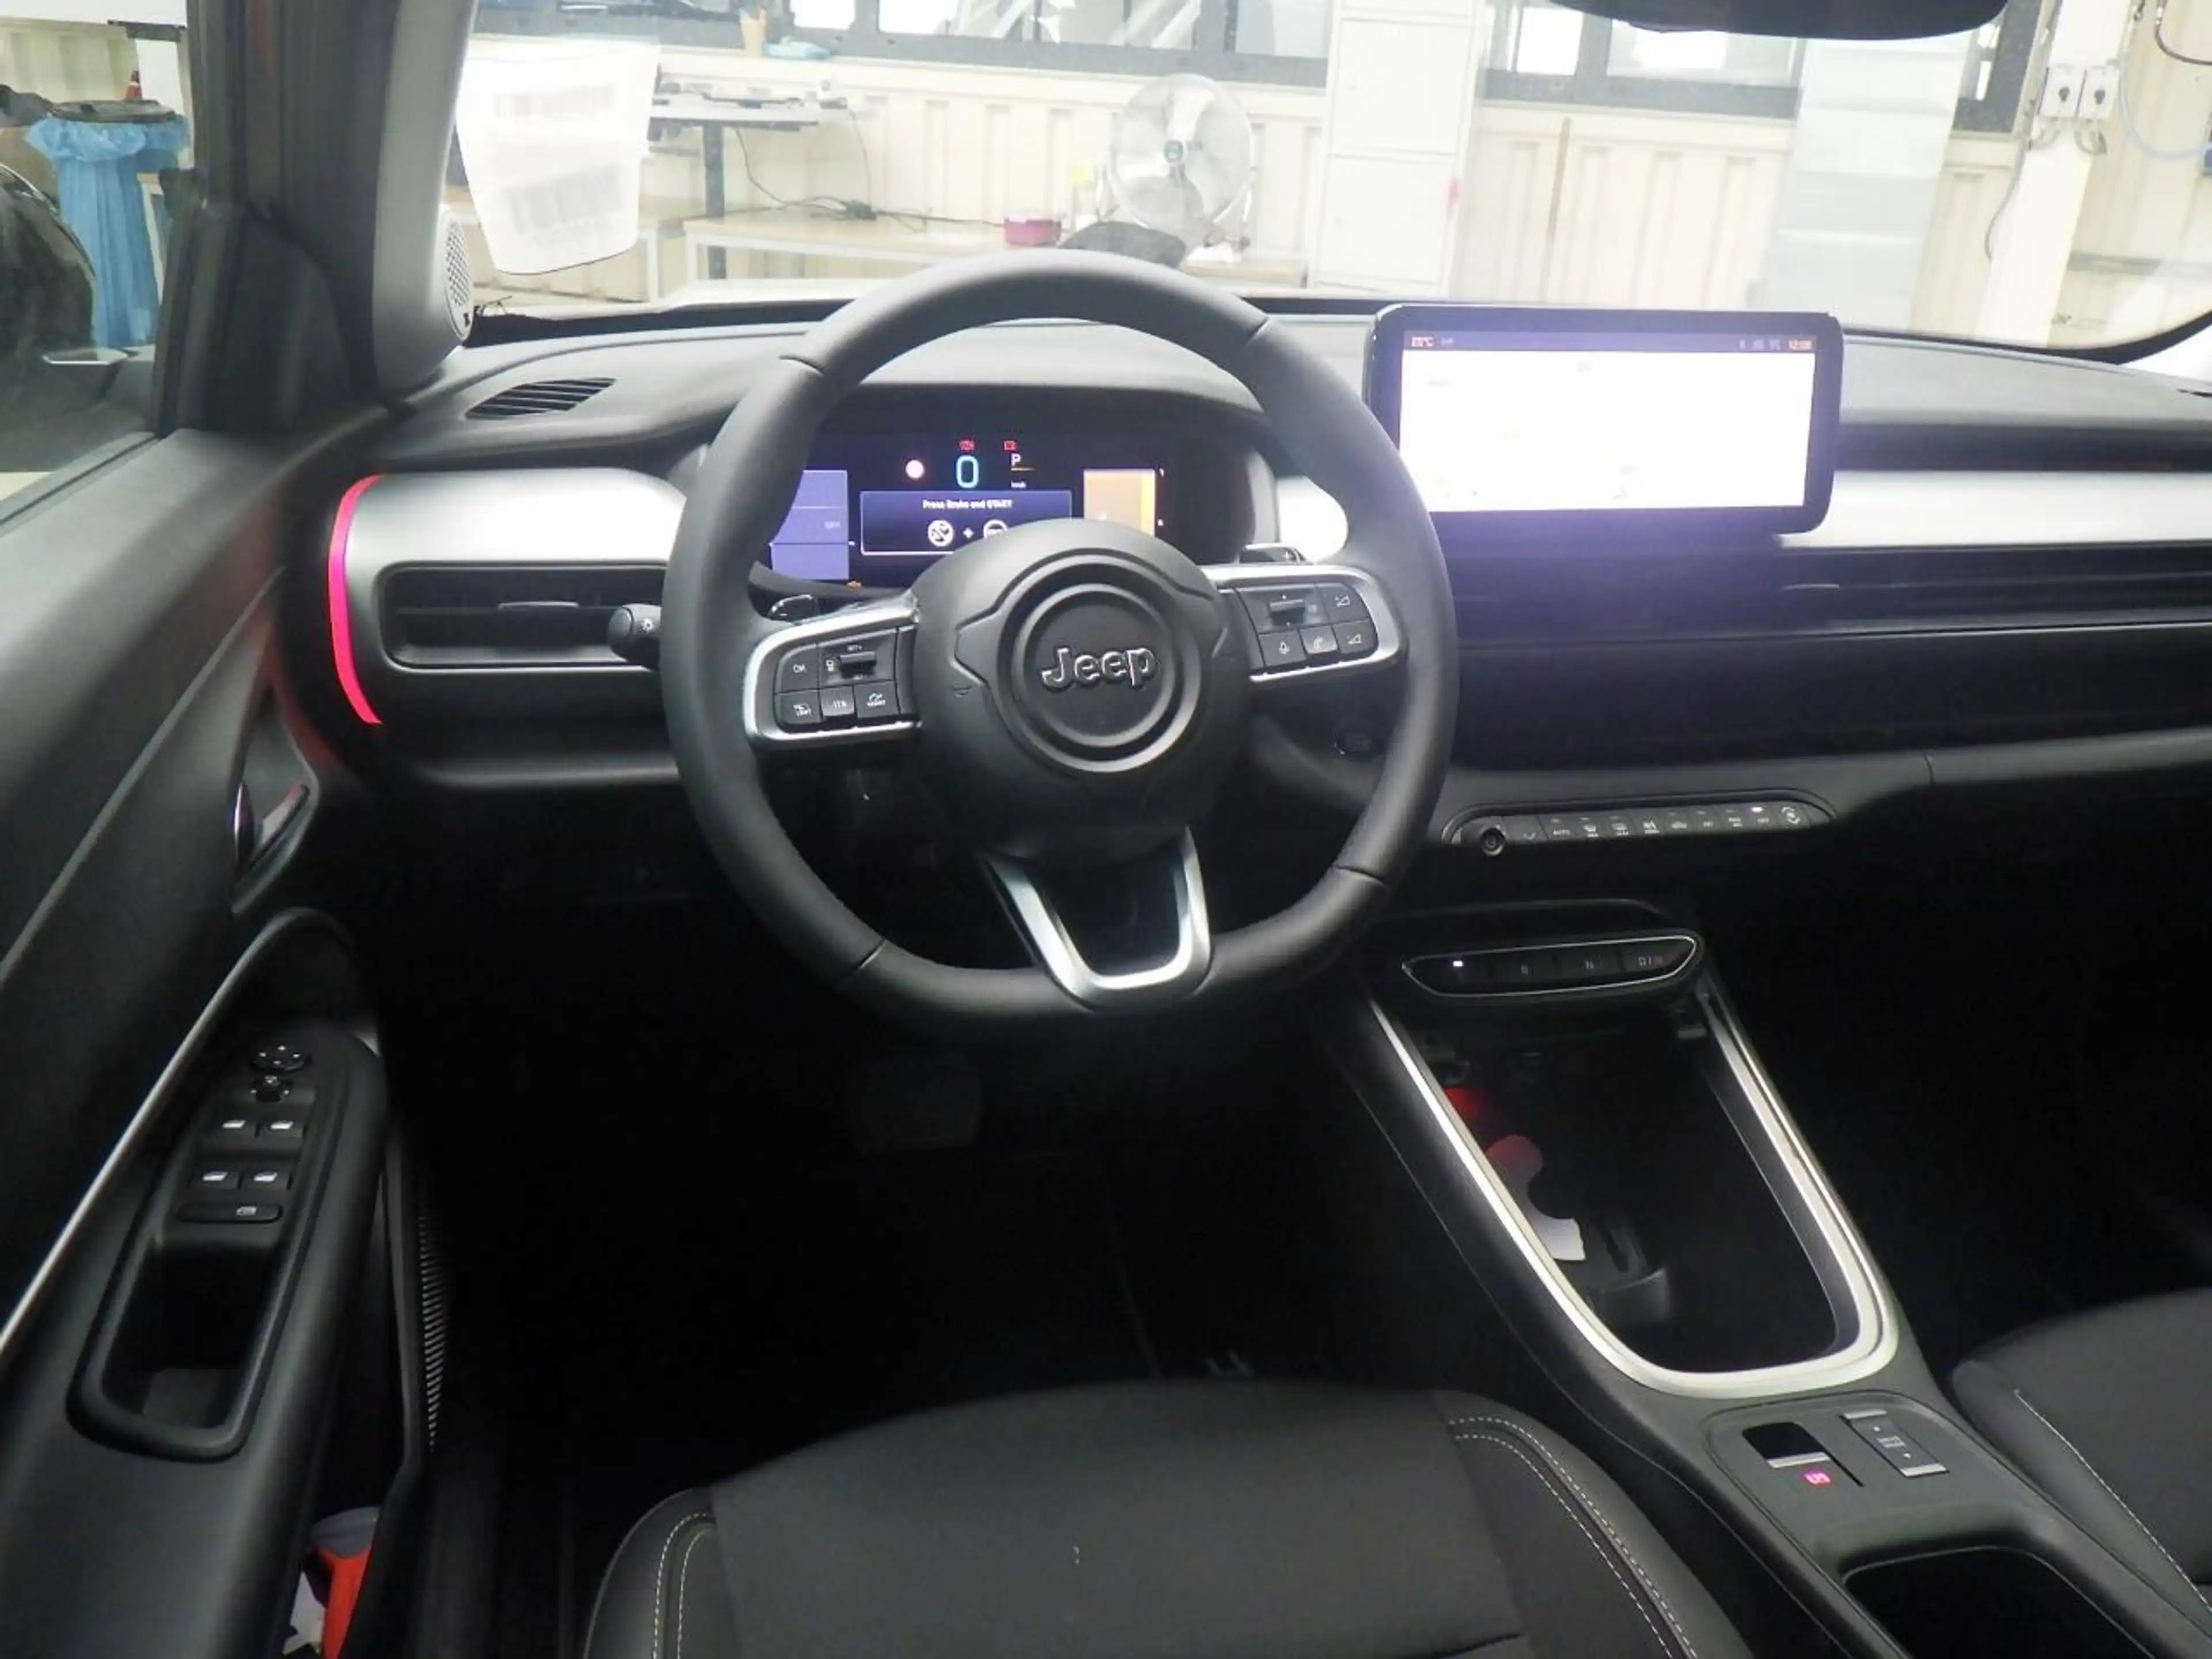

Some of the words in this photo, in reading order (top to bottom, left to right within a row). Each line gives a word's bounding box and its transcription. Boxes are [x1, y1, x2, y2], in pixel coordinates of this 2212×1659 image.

[956, 454, 979, 488] 0
[1011, 453, 1021, 467] P
[1040, 646, 1158, 691] Jeep
